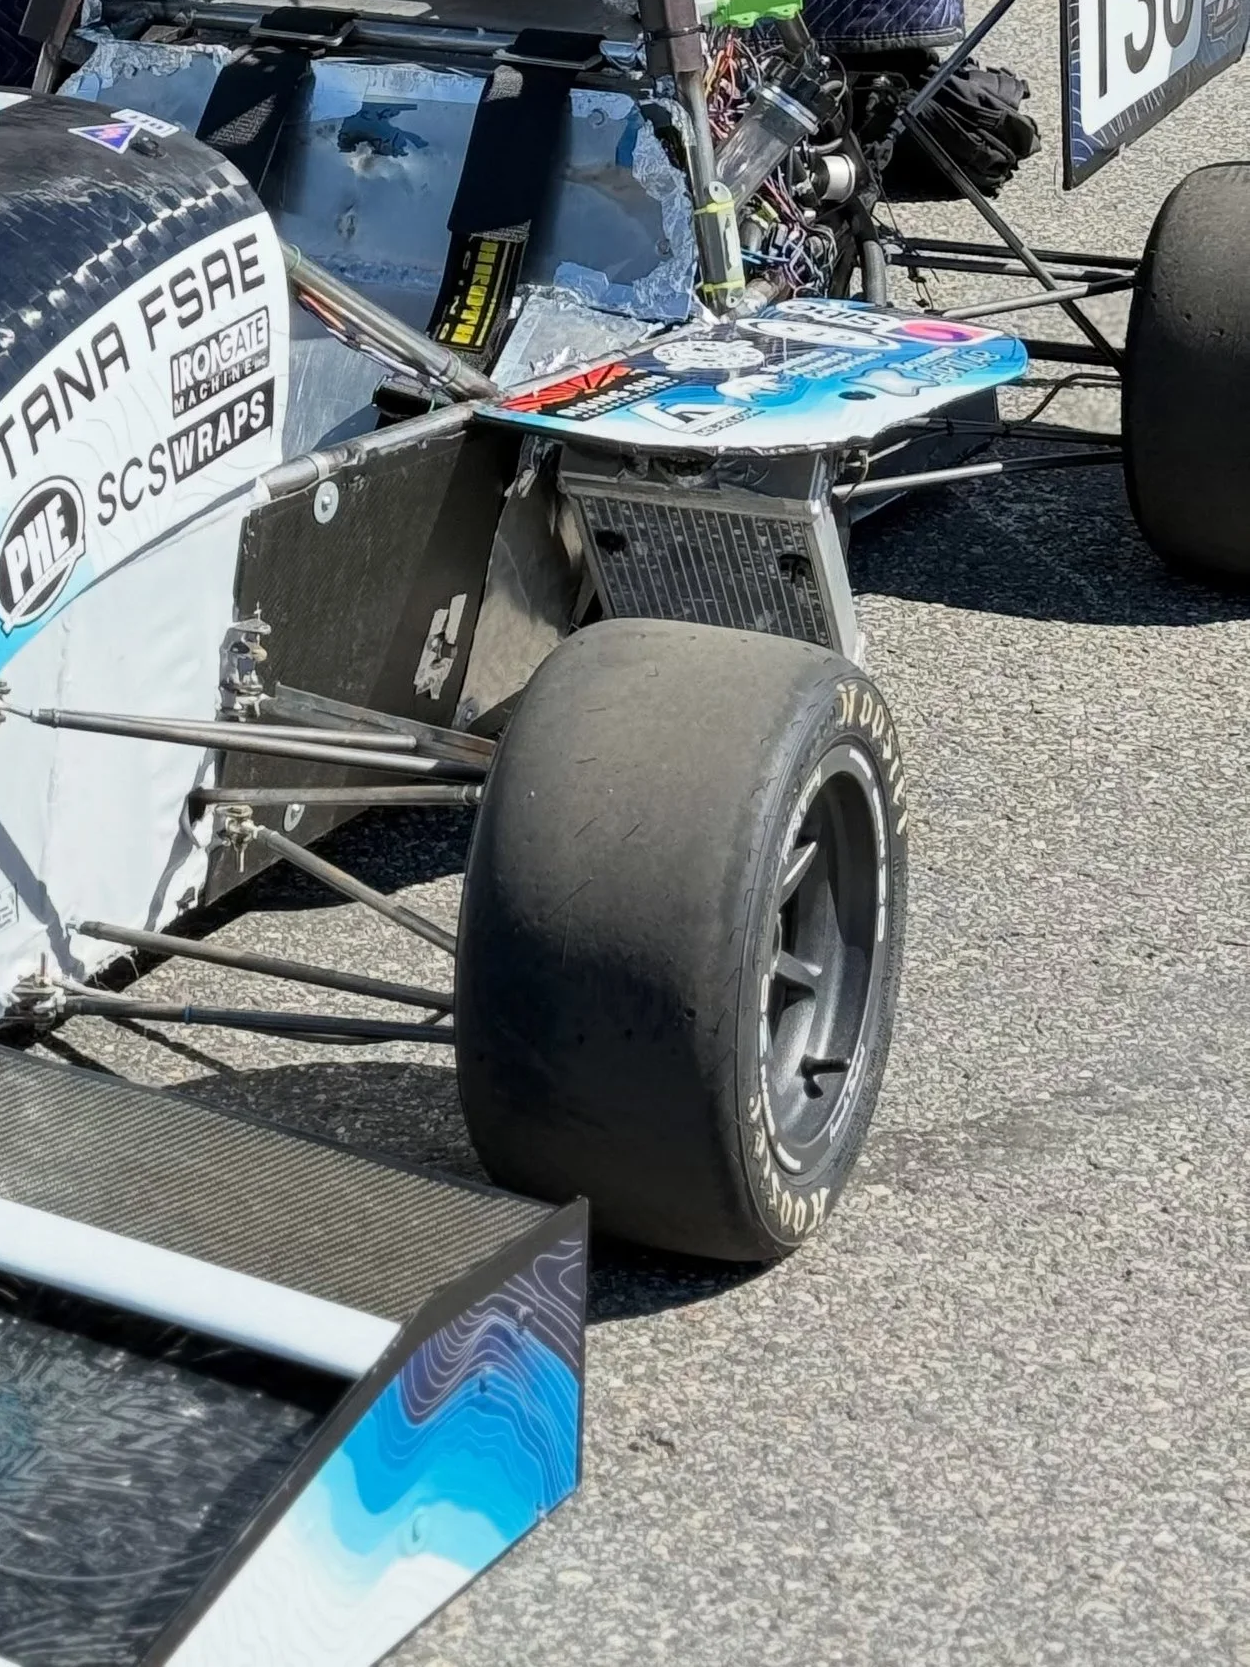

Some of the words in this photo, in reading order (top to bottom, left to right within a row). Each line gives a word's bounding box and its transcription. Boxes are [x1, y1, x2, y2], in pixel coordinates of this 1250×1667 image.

[138, 233, 265, 352] FSAE
[174, 360, 252, 414] MACHINE
[4, 493, 71, 605] PHE
